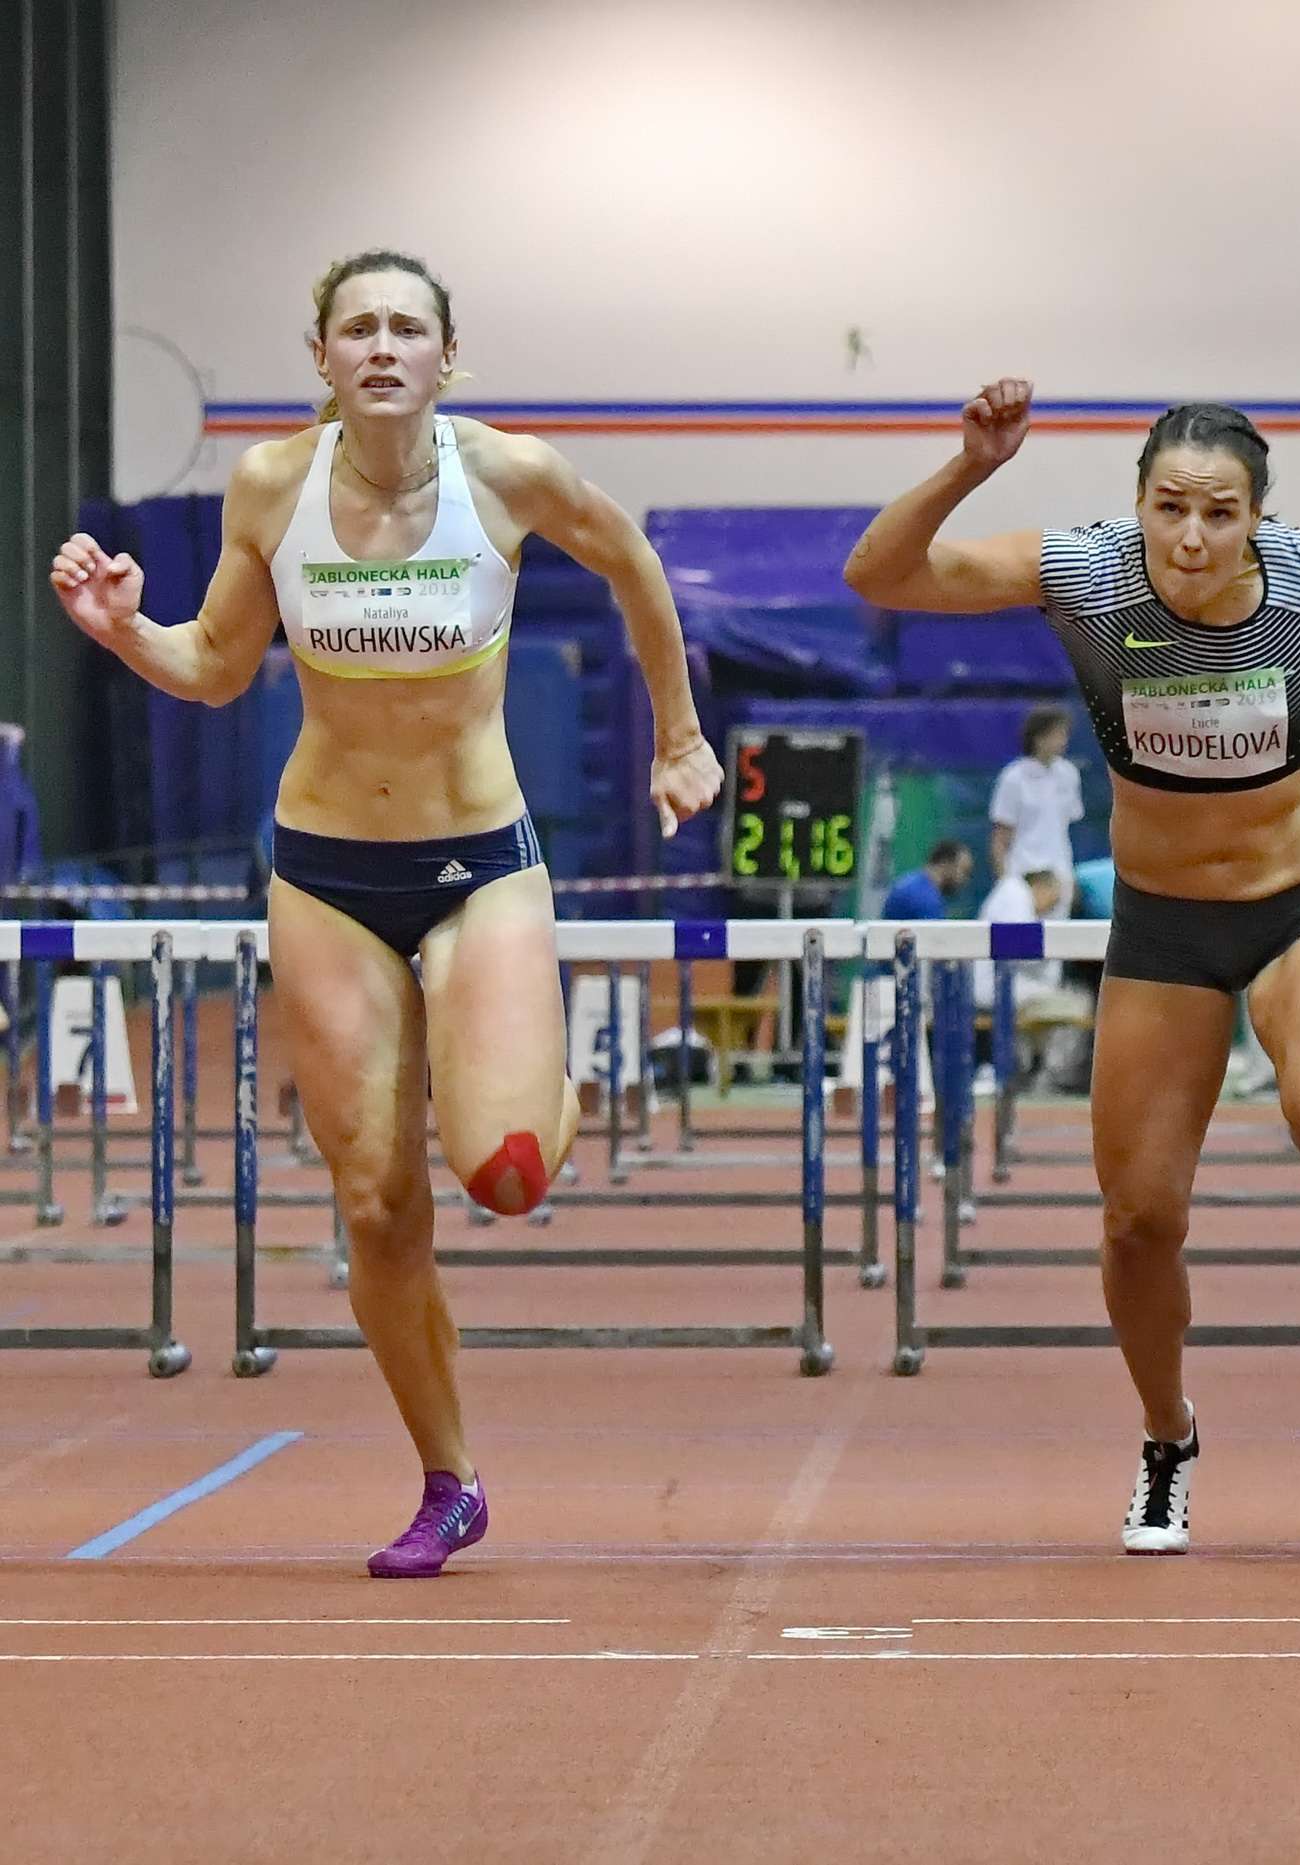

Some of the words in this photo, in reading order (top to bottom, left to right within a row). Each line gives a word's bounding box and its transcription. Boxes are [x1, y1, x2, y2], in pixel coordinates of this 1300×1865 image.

[417, 567, 460, 580] HALA
[419, 583, 461, 597] 2019
[363, 606, 409, 621] Nataliya
[310, 624, 466, 653] RUCHKIVSKA
[1235, 677, 1277, 693] HALA
[1236, 690, 1277, 707] 2019
[1134, 724, 1281, 761] KOUDELOVÁ
[738, 746, 767, 803] 5
[437, 871, 473, 883] adidas
